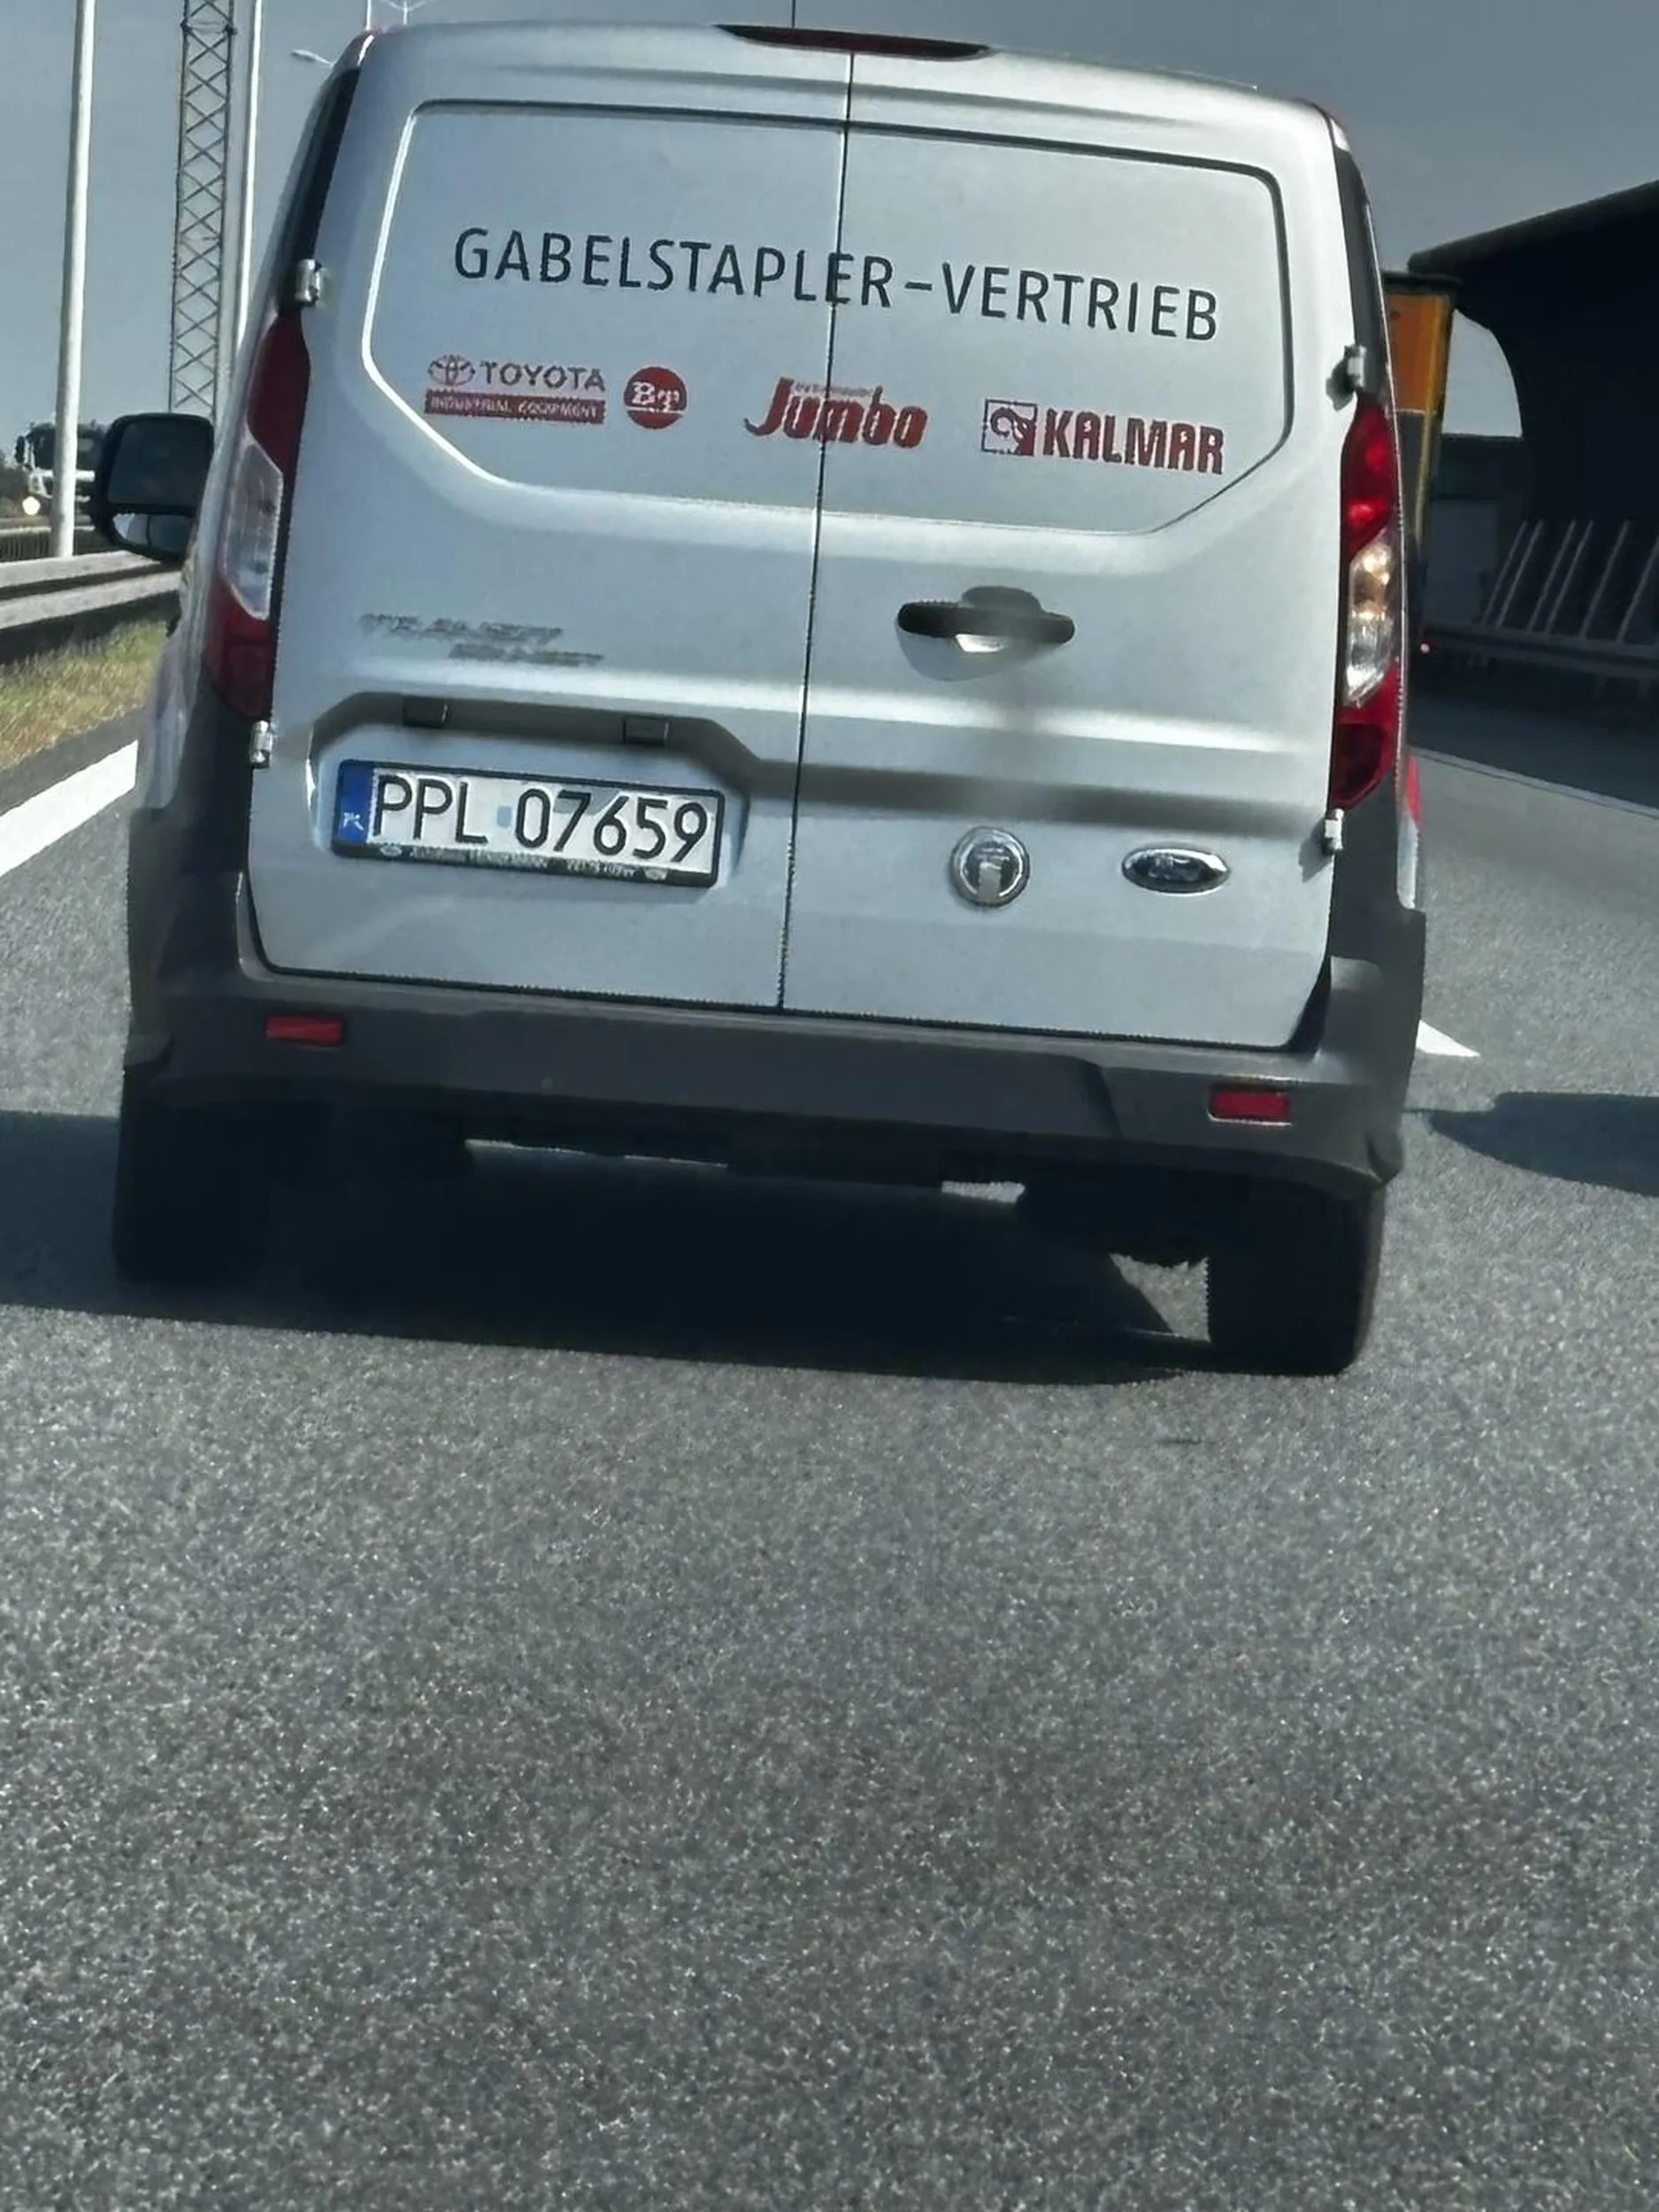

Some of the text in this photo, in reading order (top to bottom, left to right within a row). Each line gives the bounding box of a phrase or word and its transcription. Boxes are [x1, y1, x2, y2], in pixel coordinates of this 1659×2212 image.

[479, 360, 606, 392] TOYOTA
[744, 376, 928, 449] Jumbo
[1042, 407, 1225, 475] KALMAR
[372, 773, 488, 845] PPL
[514, 787, 710, 864] 07659
